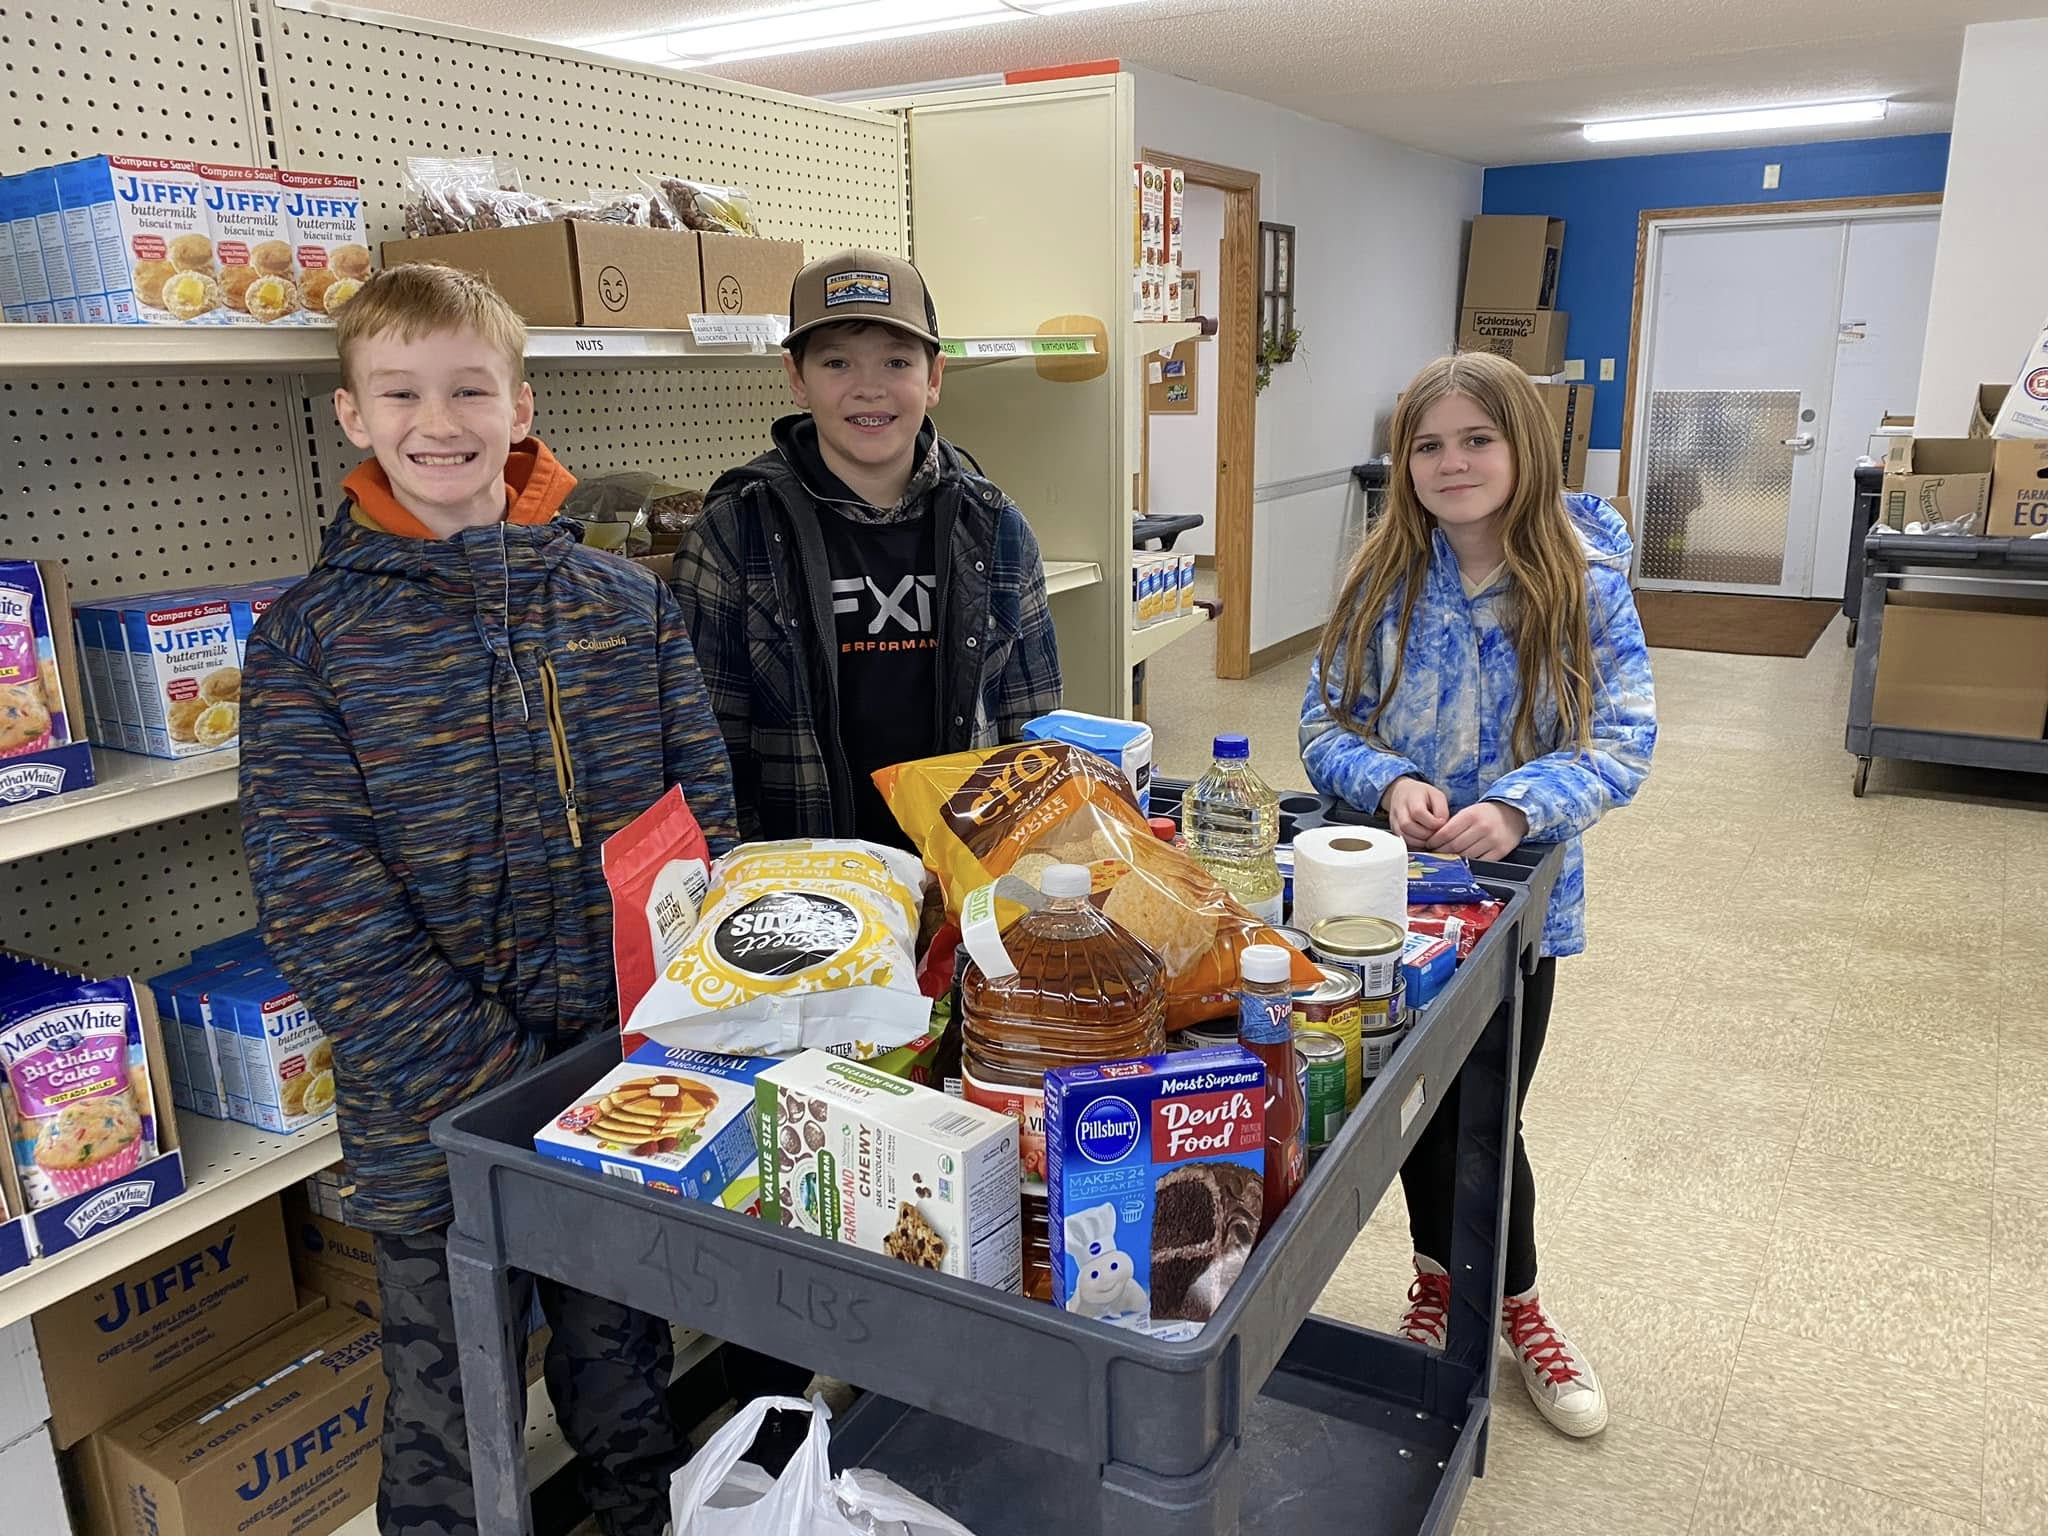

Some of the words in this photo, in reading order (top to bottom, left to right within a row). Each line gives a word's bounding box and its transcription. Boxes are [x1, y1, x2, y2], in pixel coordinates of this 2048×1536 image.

[113, 155, 158, 168] Compare
[169, 160, 195, 171] Save!
[201, 165, 243, 179] Compare
[254, 170, 277, 181] Save!
[281, 173, 323, 185] Compare
[333, 178, 356, 187] Save!
[131, 203, 197, 219] buttermilk
[216, 212, 279, 227] buttermilk
[139, 218, 172, 229] biscuit
[174, 222, 193, 231] mix
[224, 225, 255, 237] biscuit
[257, 228, 275, 237] mix
[296, 217, 356, 231] buttermilk
[303, 232, 334, 241] biscuit
[335, 233, 353, 241] mix
[1476, 315, 1532, 328] Schlotzsky's
[1479, 327, 1528, 337] CATERING
[575, 339, 604, 351] NUTS
[977, 343, 993, 353] BOYS
[1041, 343, 1065, 351] BIRTHDAY
[150, 610, 193, 623] Compare
[203, 603, 227, 615] Save!
[578, 635, 628, 650] Columbia
[842, 639, 939, 653] ERFORMAN
[166, 644, 228, 665] buttermilk
[173, 661, 204, 674] biscuit
[206, 659, 224, 669] mix
[1010, 794, 1065, 842] WHITE
[278, 1024, 319, 1047] butterm
[22, 1046, 118, 1084] Birthday
[664, 1047, 750, 1071] ORIGINAL
[666, 1060, 709, 1073] PANCAKE
[708, 1068, 729, 1076] MIX
[48, 1064, 101, 1087] Cake
[832, 1064, 882, 1087] CASCADIAN
[881, 1078, 909, 1094] FARM
[1160, 1077, 1204, 1096] Moist
[1204, 1072, 1259, 1088] Supreme
[50, 1093, 68, 1104] JUST
[70, 1087, 88, 1098] ADD
[825, 1078, 875, 1098] CHEWY
[1160, 1092, 1253, 1131] Devil's
[762, 1112, 772, 1148] SIZE
[1080, 1119, 1138, 1142] Pillsbury
[1167, 1121, 1235, 1157] Food
[823, 1155, 831, 1182] FARM
[858, 1123, 872, 1199] CHEWY
[875, 1145, 883, 1190] CHOCOLATE
[764, 1154, 774, 1203] VALUE
[1069, 1170, 1125, 1188] MAKES
[1127, 1167, 1145, 1180] 24
[1069, 1179, 1145, 1198] CUPCAKES
[842, 1168, 857, 1244] FARMLAND
[328, 1239, 377, 1266] PILLSBU
[776, 1268, 872, 1343] LBS
[97, 1330, 149, 1364] CHELSEA
[151, 1303, 197, 1332] MILLING
[199, 1273, 249, 1306] COMPANY
[320, 1330, 377, 1368] MIXES
[265, 1390, 302, 1413] BEST
[250, 1413, 264, 1424] IF
[206, 1422, 248, 1450] USED
[237, 1495, 288, 1532] CHELSEA
[290, 1465, 335, 1498] MILLING
